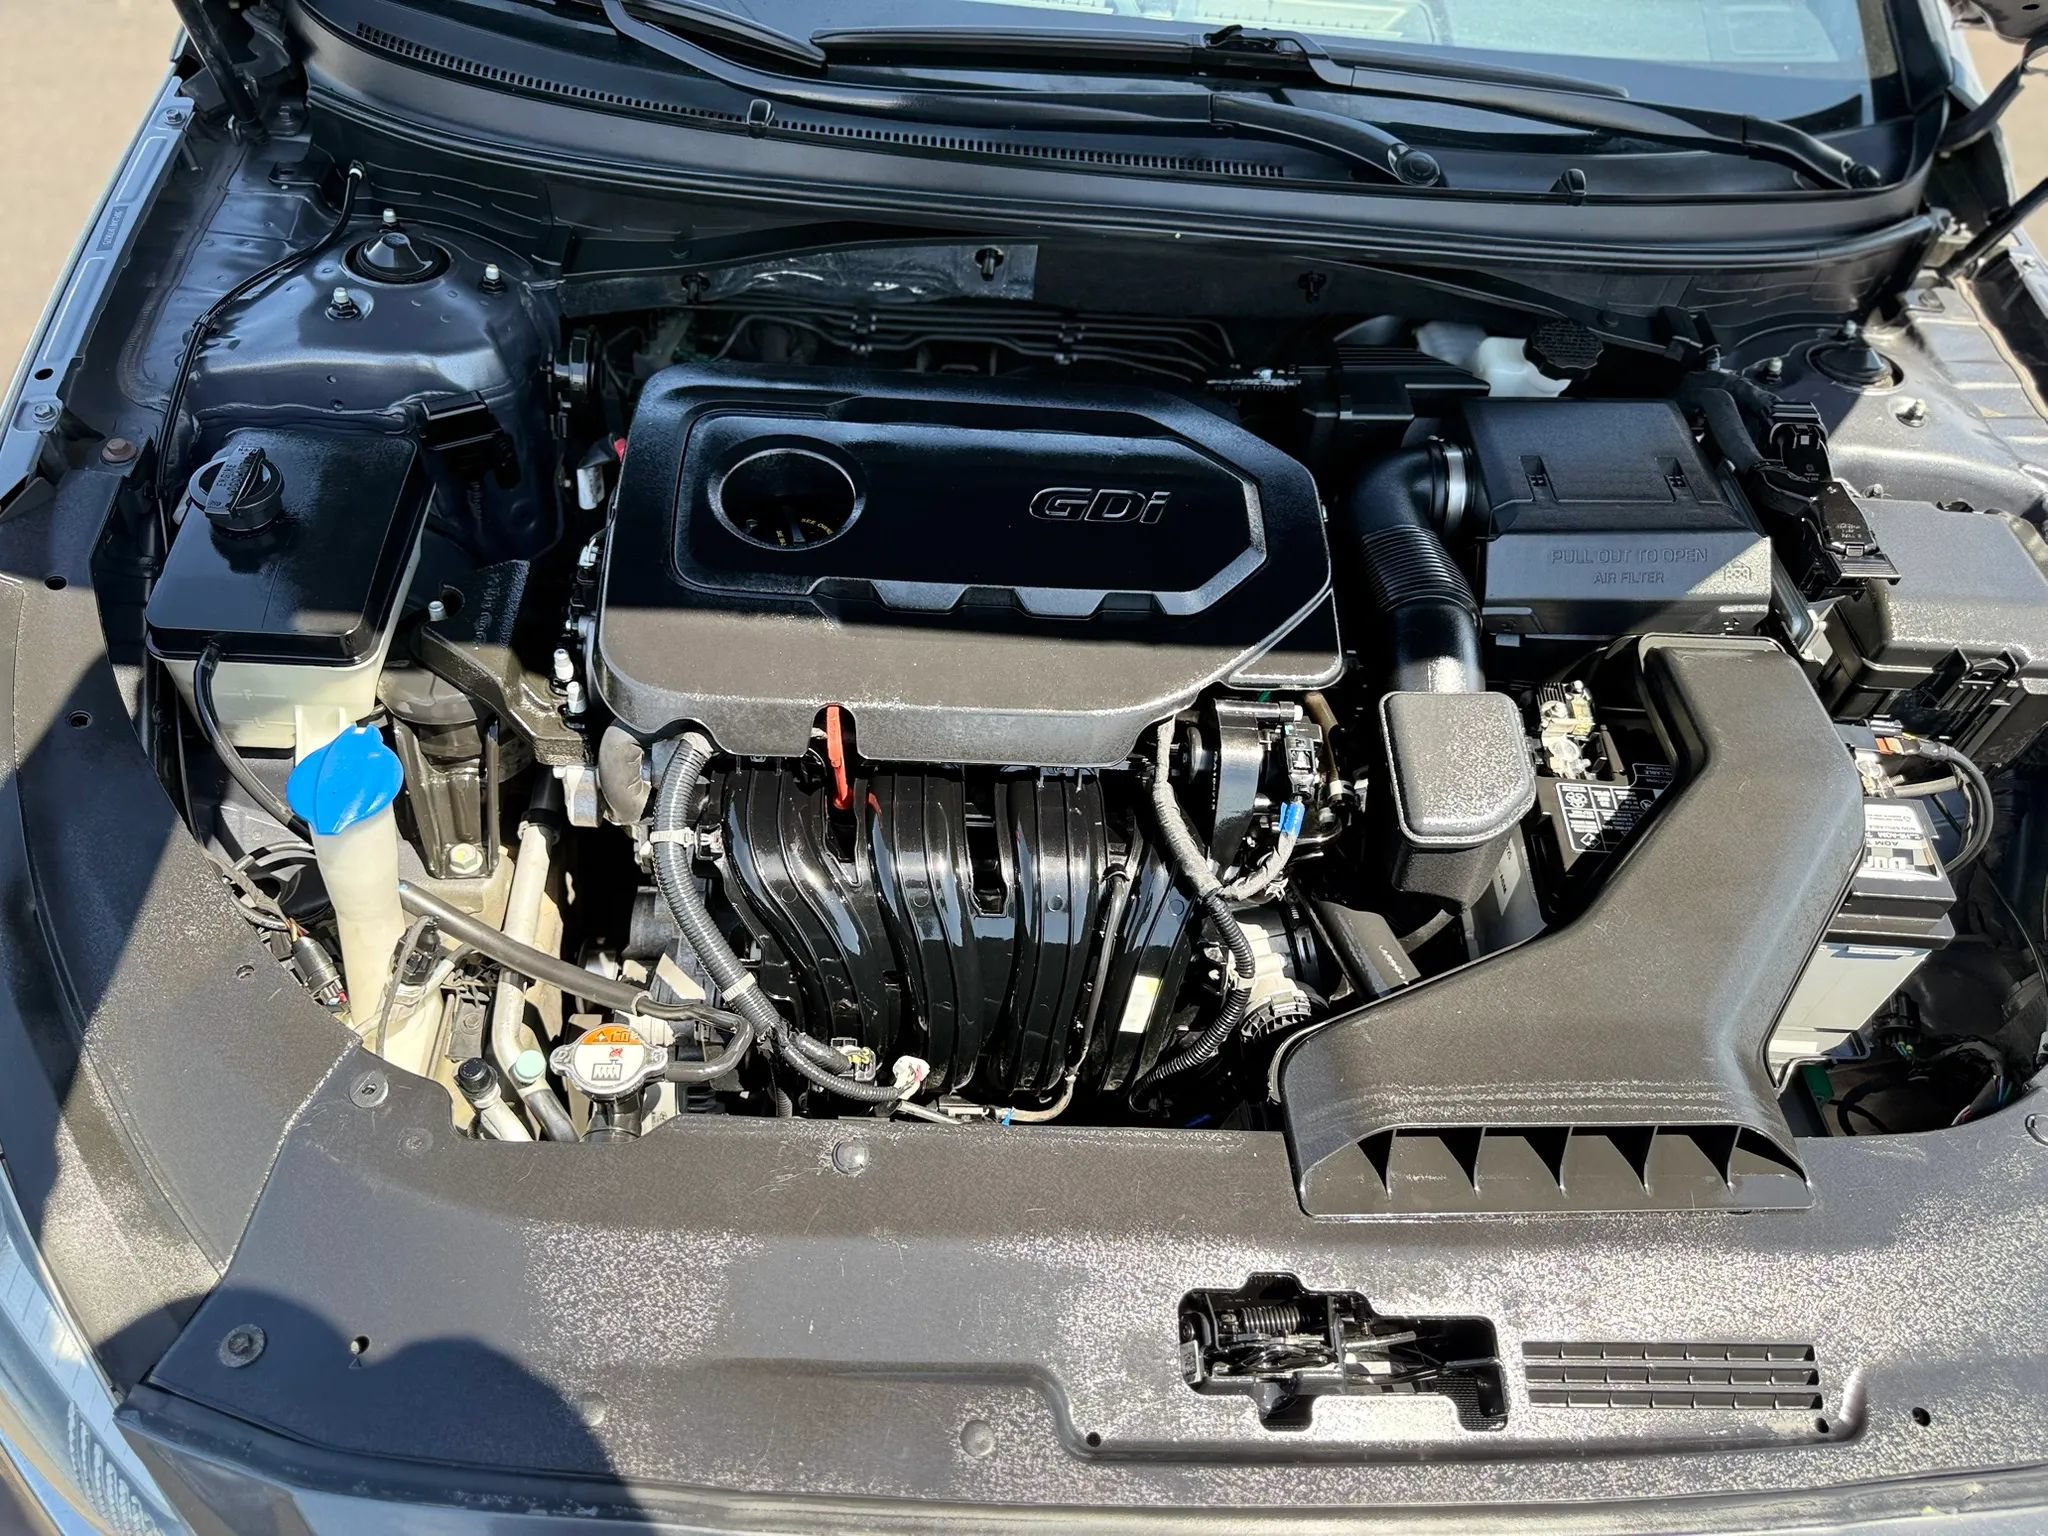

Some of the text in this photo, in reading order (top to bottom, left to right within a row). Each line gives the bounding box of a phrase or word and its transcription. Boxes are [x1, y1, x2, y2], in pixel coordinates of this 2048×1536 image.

[1029, 487, 1171, 524] GDi
[1551, 548, 1708, 564] PULL OUT TO OPEN
[1594, 572, 1664, 584] AIR FILTER
